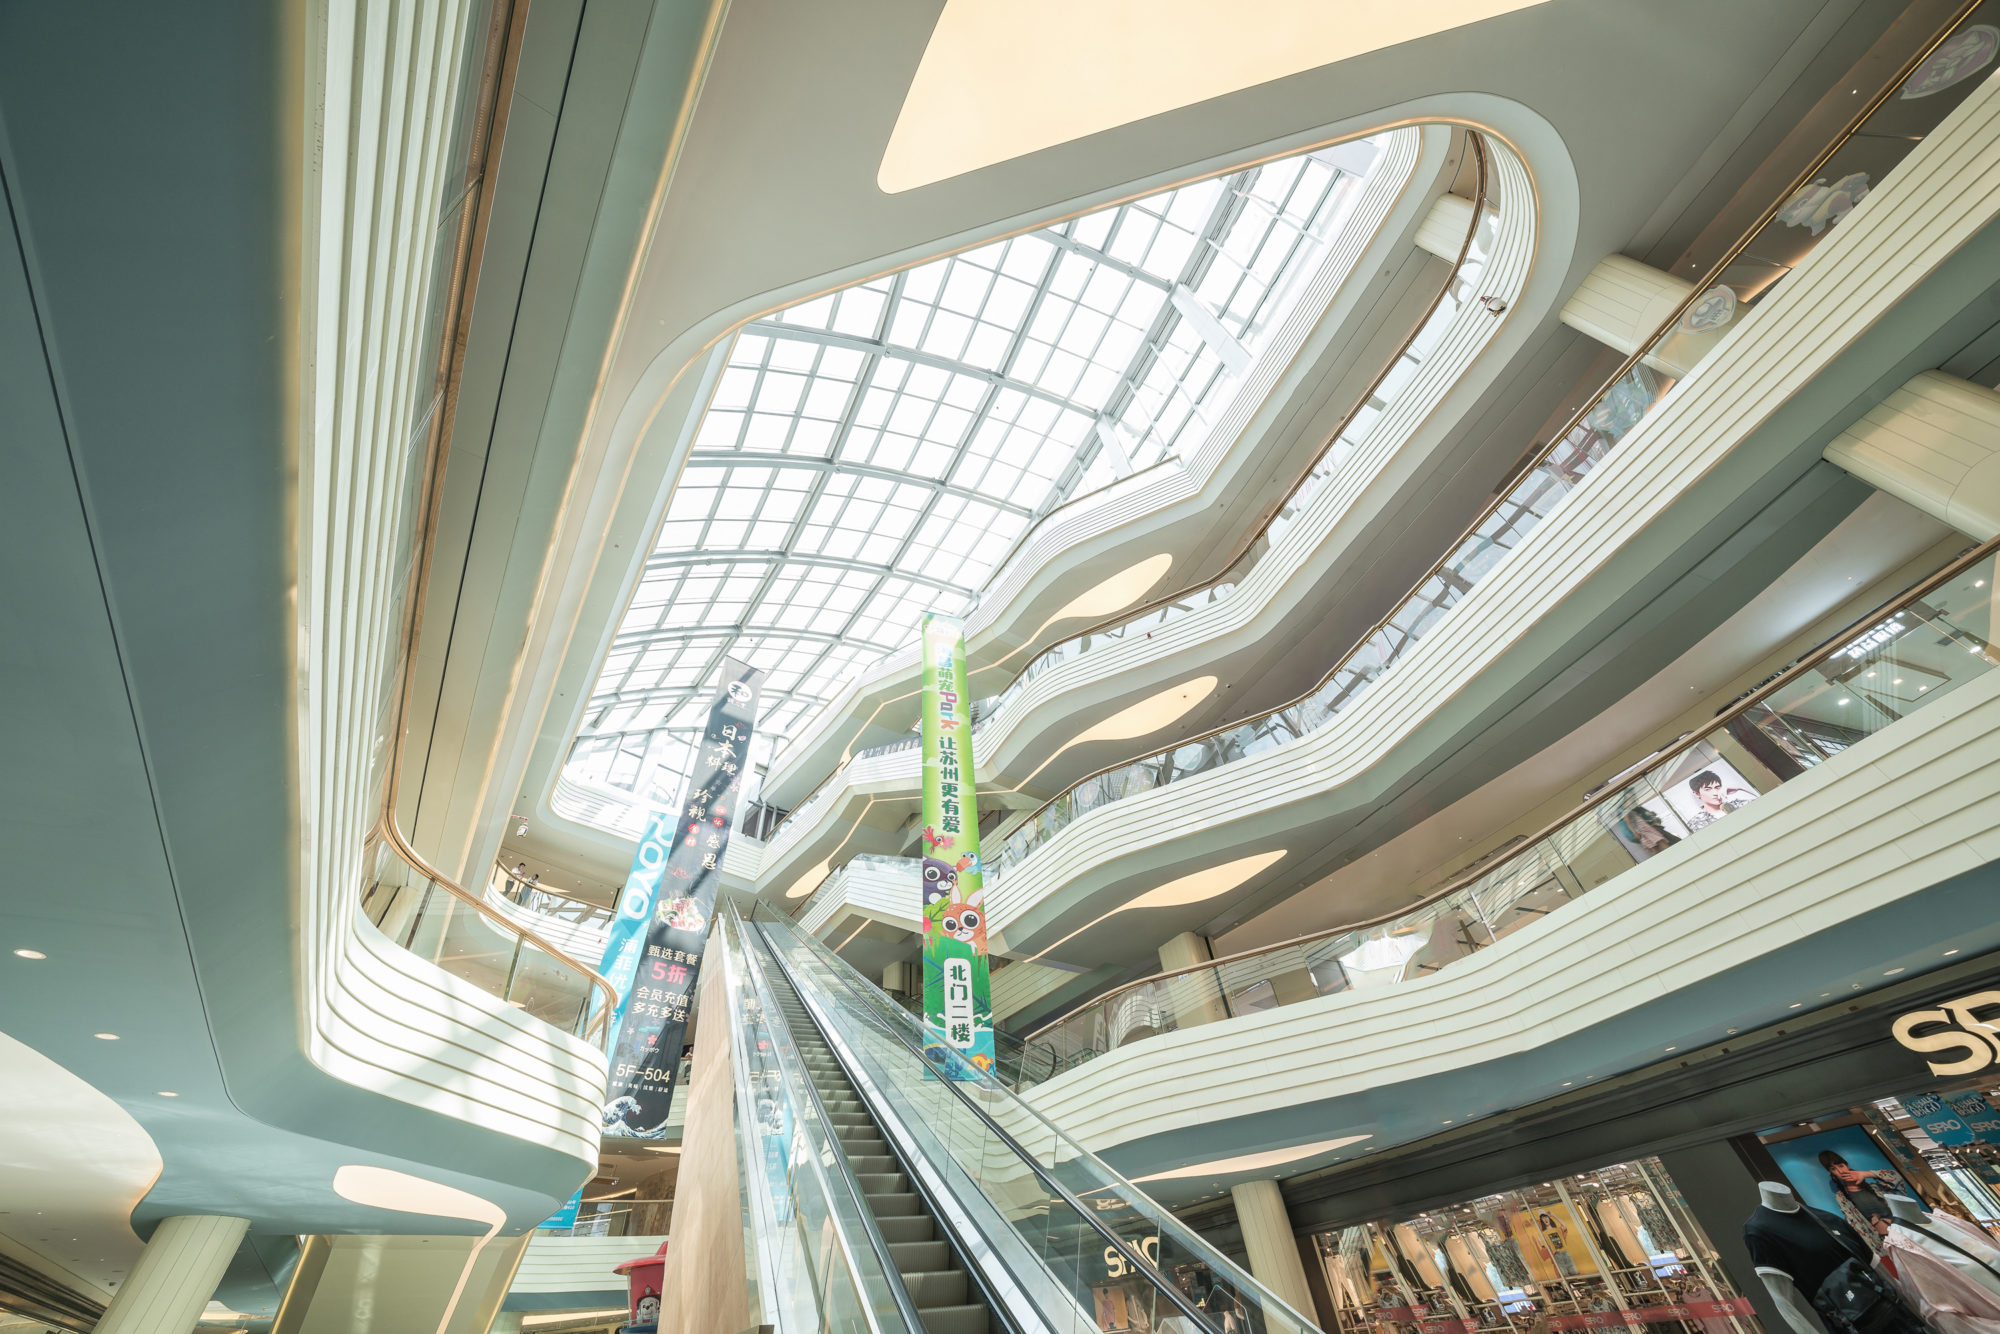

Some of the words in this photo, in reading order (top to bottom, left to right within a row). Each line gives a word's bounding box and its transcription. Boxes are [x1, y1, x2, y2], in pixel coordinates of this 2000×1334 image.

[704, 724, 738, 776] 日本料理
[939, 736, 961, 834] 让苏州更有爱
[647, 944, 699, 967] 甄选套餐
[651, 961, 688, 985] 5折
[636, 985, 690, 1008] 会员充值
[949, 964, 970, 1043] 北门二楼
[631, 1001, 687, 1023] 多充多送
[1926, 1119, 1961, 1135] SPAO
